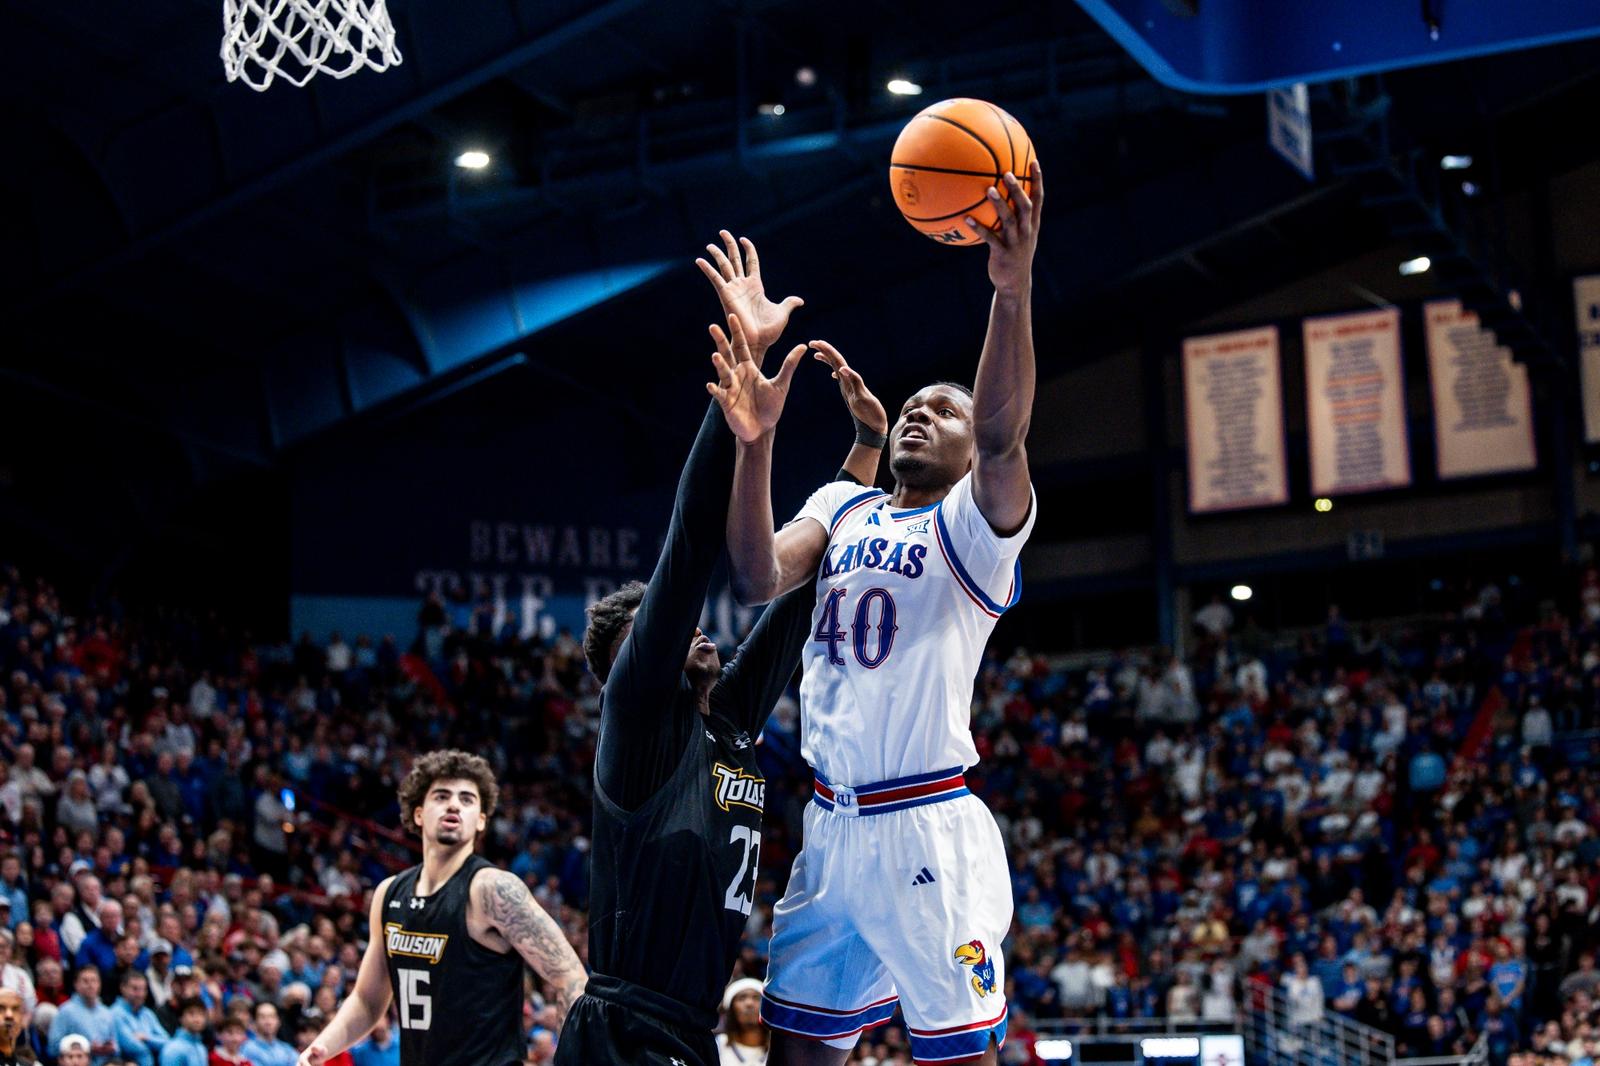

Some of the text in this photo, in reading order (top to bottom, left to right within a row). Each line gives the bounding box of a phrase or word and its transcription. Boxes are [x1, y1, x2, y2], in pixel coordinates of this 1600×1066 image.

[468, 519, 641, 568] BEWARE
[821, 537, 927, 579] KANSAS
[814, 588, 898, 669] 40
[385, 923, 449, 963] TOWSON
[397, 968, 432, 1031] 15
